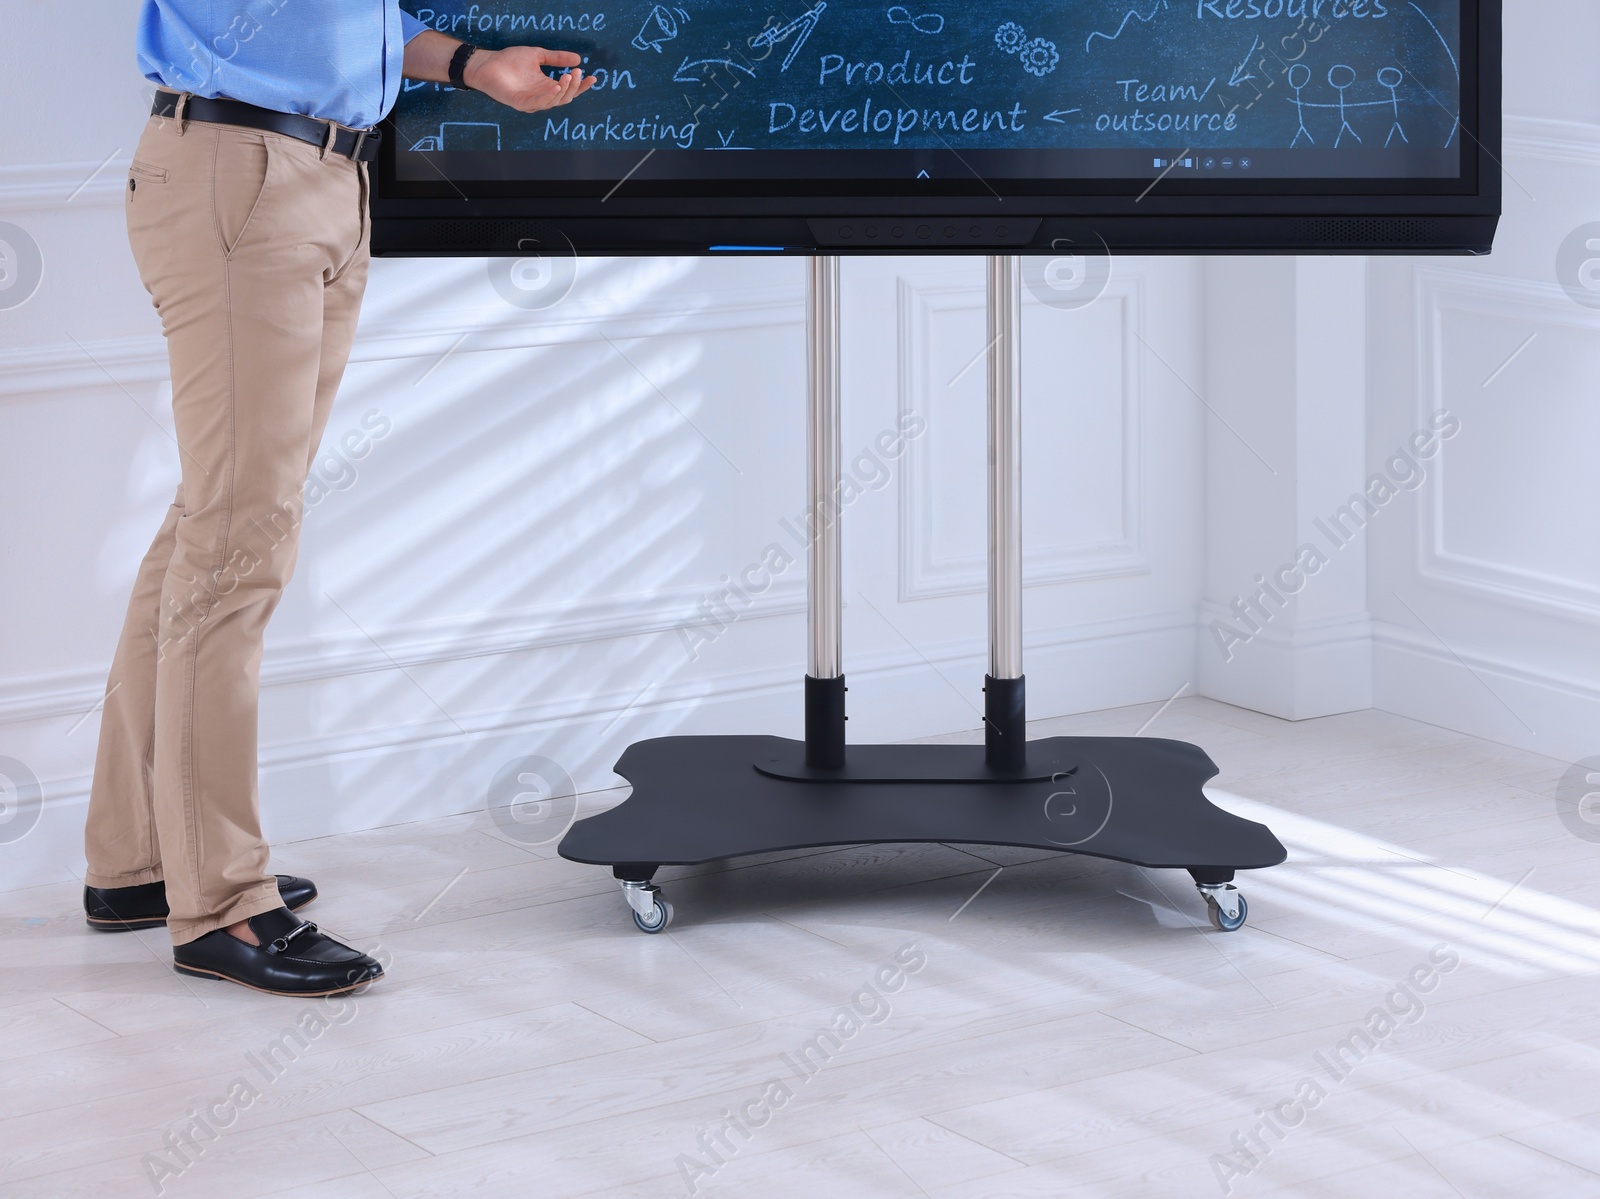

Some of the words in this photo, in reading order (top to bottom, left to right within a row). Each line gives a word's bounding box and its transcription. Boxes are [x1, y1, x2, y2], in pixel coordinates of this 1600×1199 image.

[416, 5, 607, 32] Performance
[820, 50, 975, 84] Product
[544, 115, 695, 148] Marketing
[769, 98, 1026, 144] Development
[1096, 109, 1237, 131] outsource
